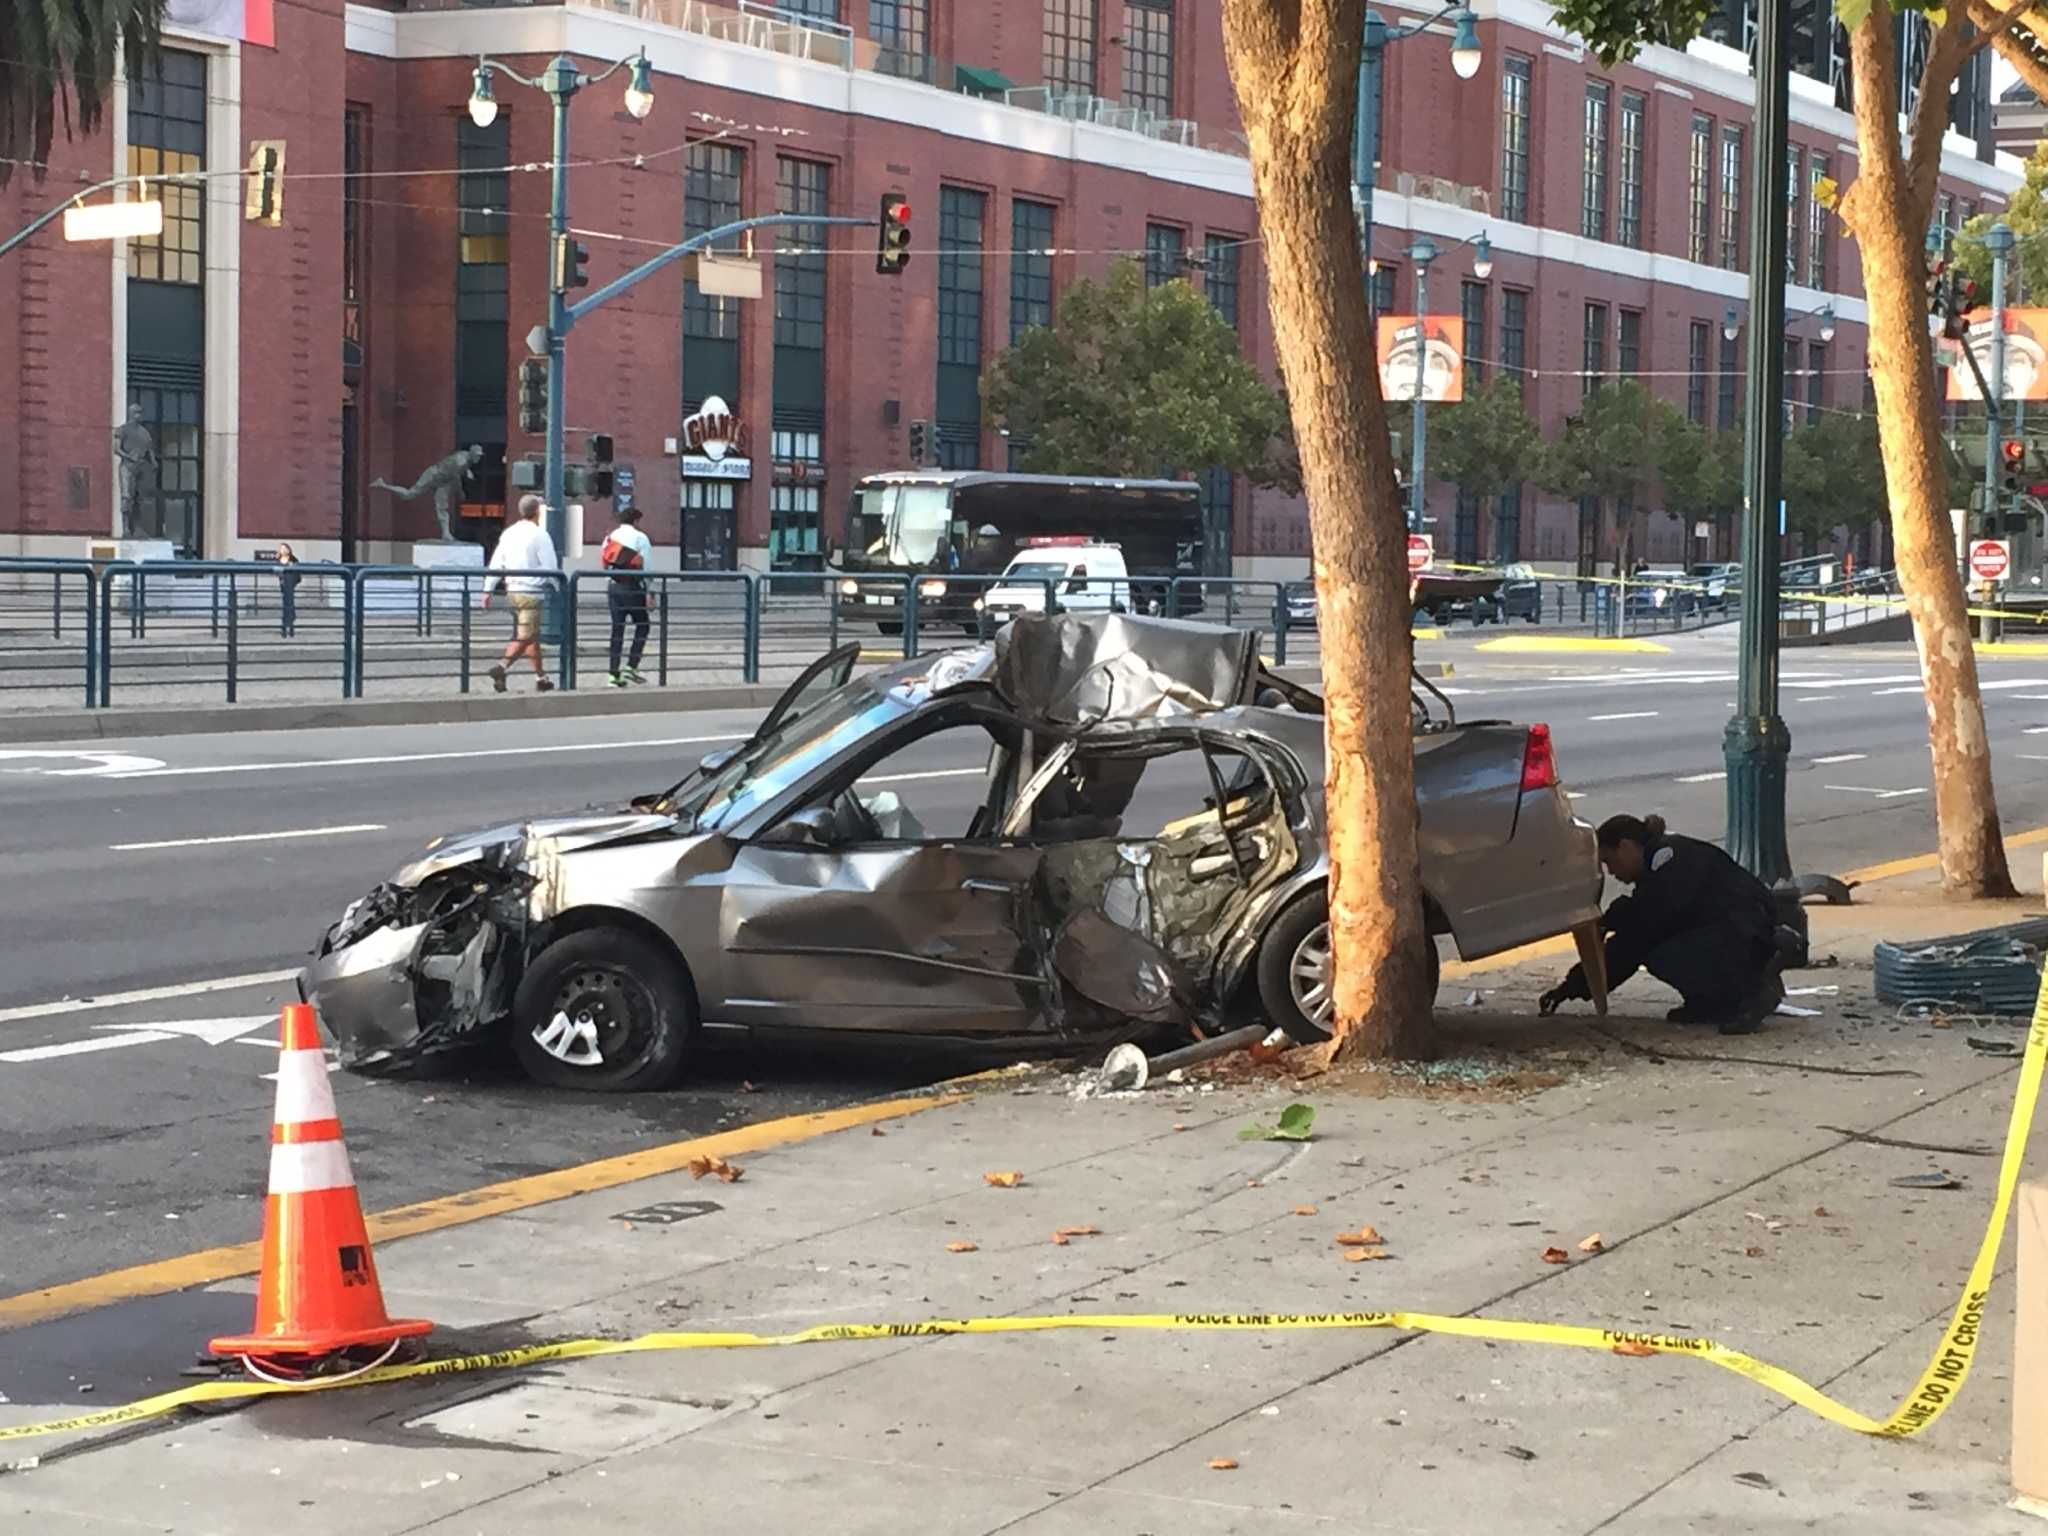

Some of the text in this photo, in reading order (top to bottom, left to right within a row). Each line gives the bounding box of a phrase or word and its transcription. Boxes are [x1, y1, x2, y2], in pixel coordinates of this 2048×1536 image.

[687, 413, 749, 450] GIANTS
[1175, 1312, 1387, 1325] POLICE LINE DO NOT CROS
[1603, 1329, 1660, 1346] POLICE
[1665, 1335, 1702, 1350] LINE
[1902, 1291, 1987, 1428] LINE DO NOT CROSS
